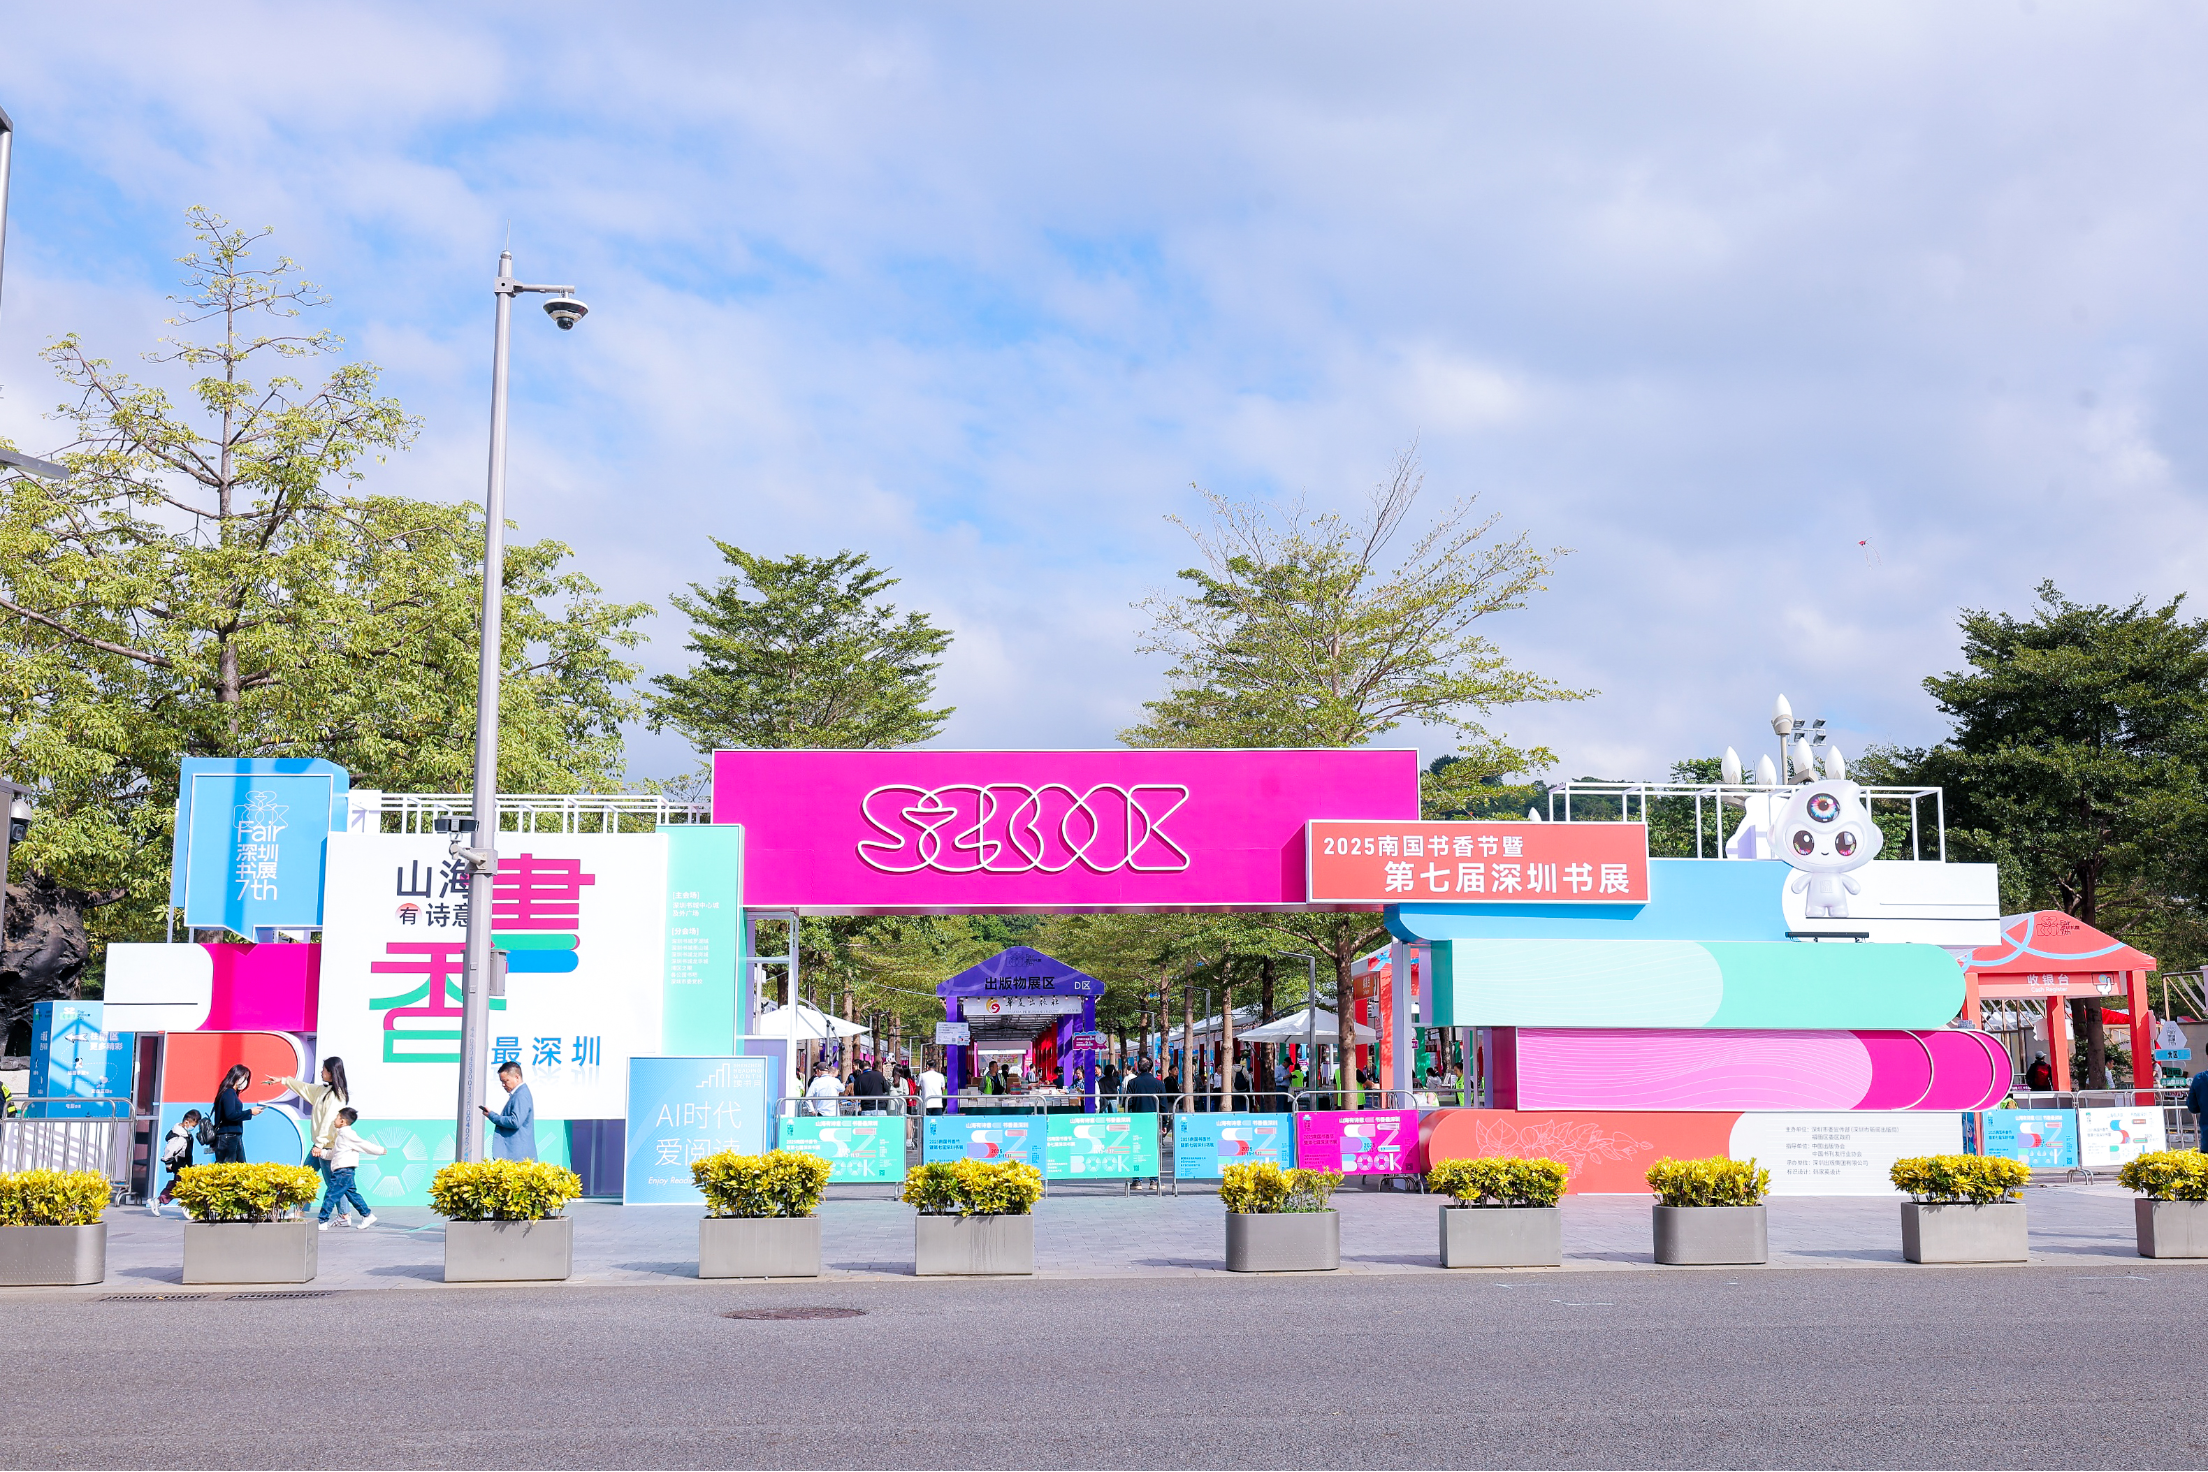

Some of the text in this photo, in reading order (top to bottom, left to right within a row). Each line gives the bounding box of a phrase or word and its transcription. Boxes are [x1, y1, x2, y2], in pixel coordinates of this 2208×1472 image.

[237, 820, 287, 842] Fair
[236, 844, 279, 861] 深圳
[1323, 834, 1525, 858] 2025南国书香节暨
[236, 862, 277, 879] 书展
[1383, 861, 1631, 895] 第七届深圳书展
[235, 879, 278, 901] 7th
[984, 976, 1091, 991] 出版物展区 D区
[2026, 973, 2070, 986] 收银台
[491, 1035, 601, 1068] 最深圳
[655, 1101, 742, 1129] AI时代
[648, 1176, 668, 1186] Enjoy
